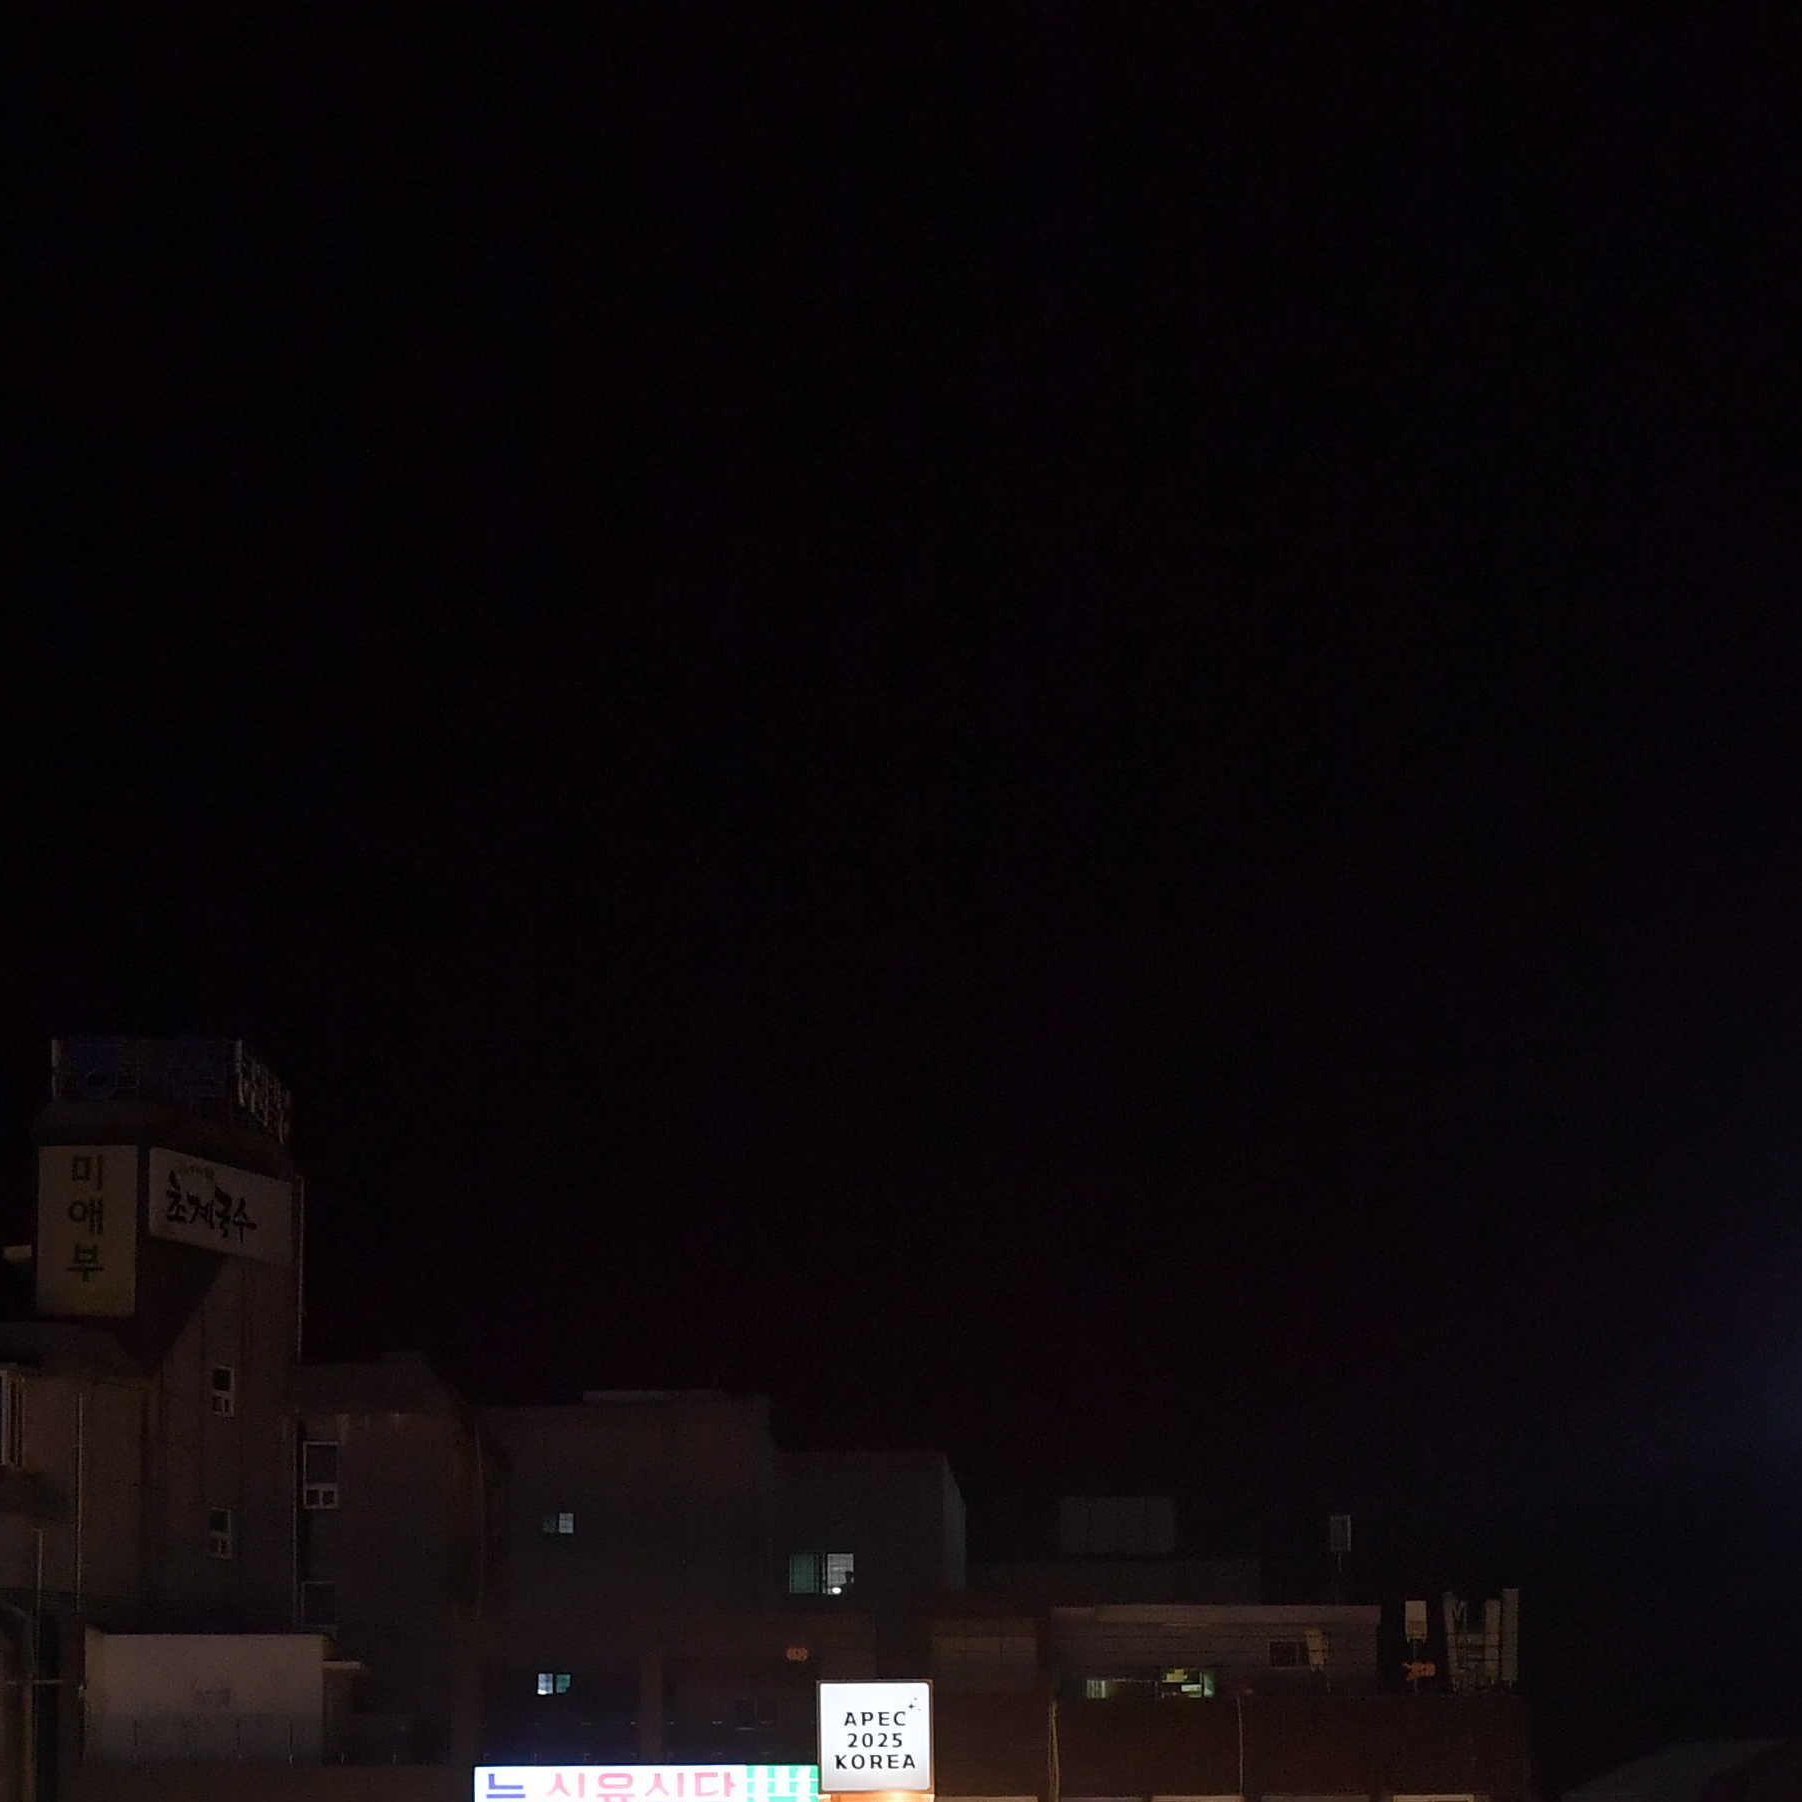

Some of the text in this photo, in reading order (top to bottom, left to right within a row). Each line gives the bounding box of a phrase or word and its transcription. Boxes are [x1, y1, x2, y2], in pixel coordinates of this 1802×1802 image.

[165, 1170, 257, 1243] 초계국수
[66, 1154, 105, 1282] 미애부
[844, 1711, 907, 1727] APEC
[847, 1732, 904, 1749] 2025
[834, 1755, 916, 1770] KOREA
